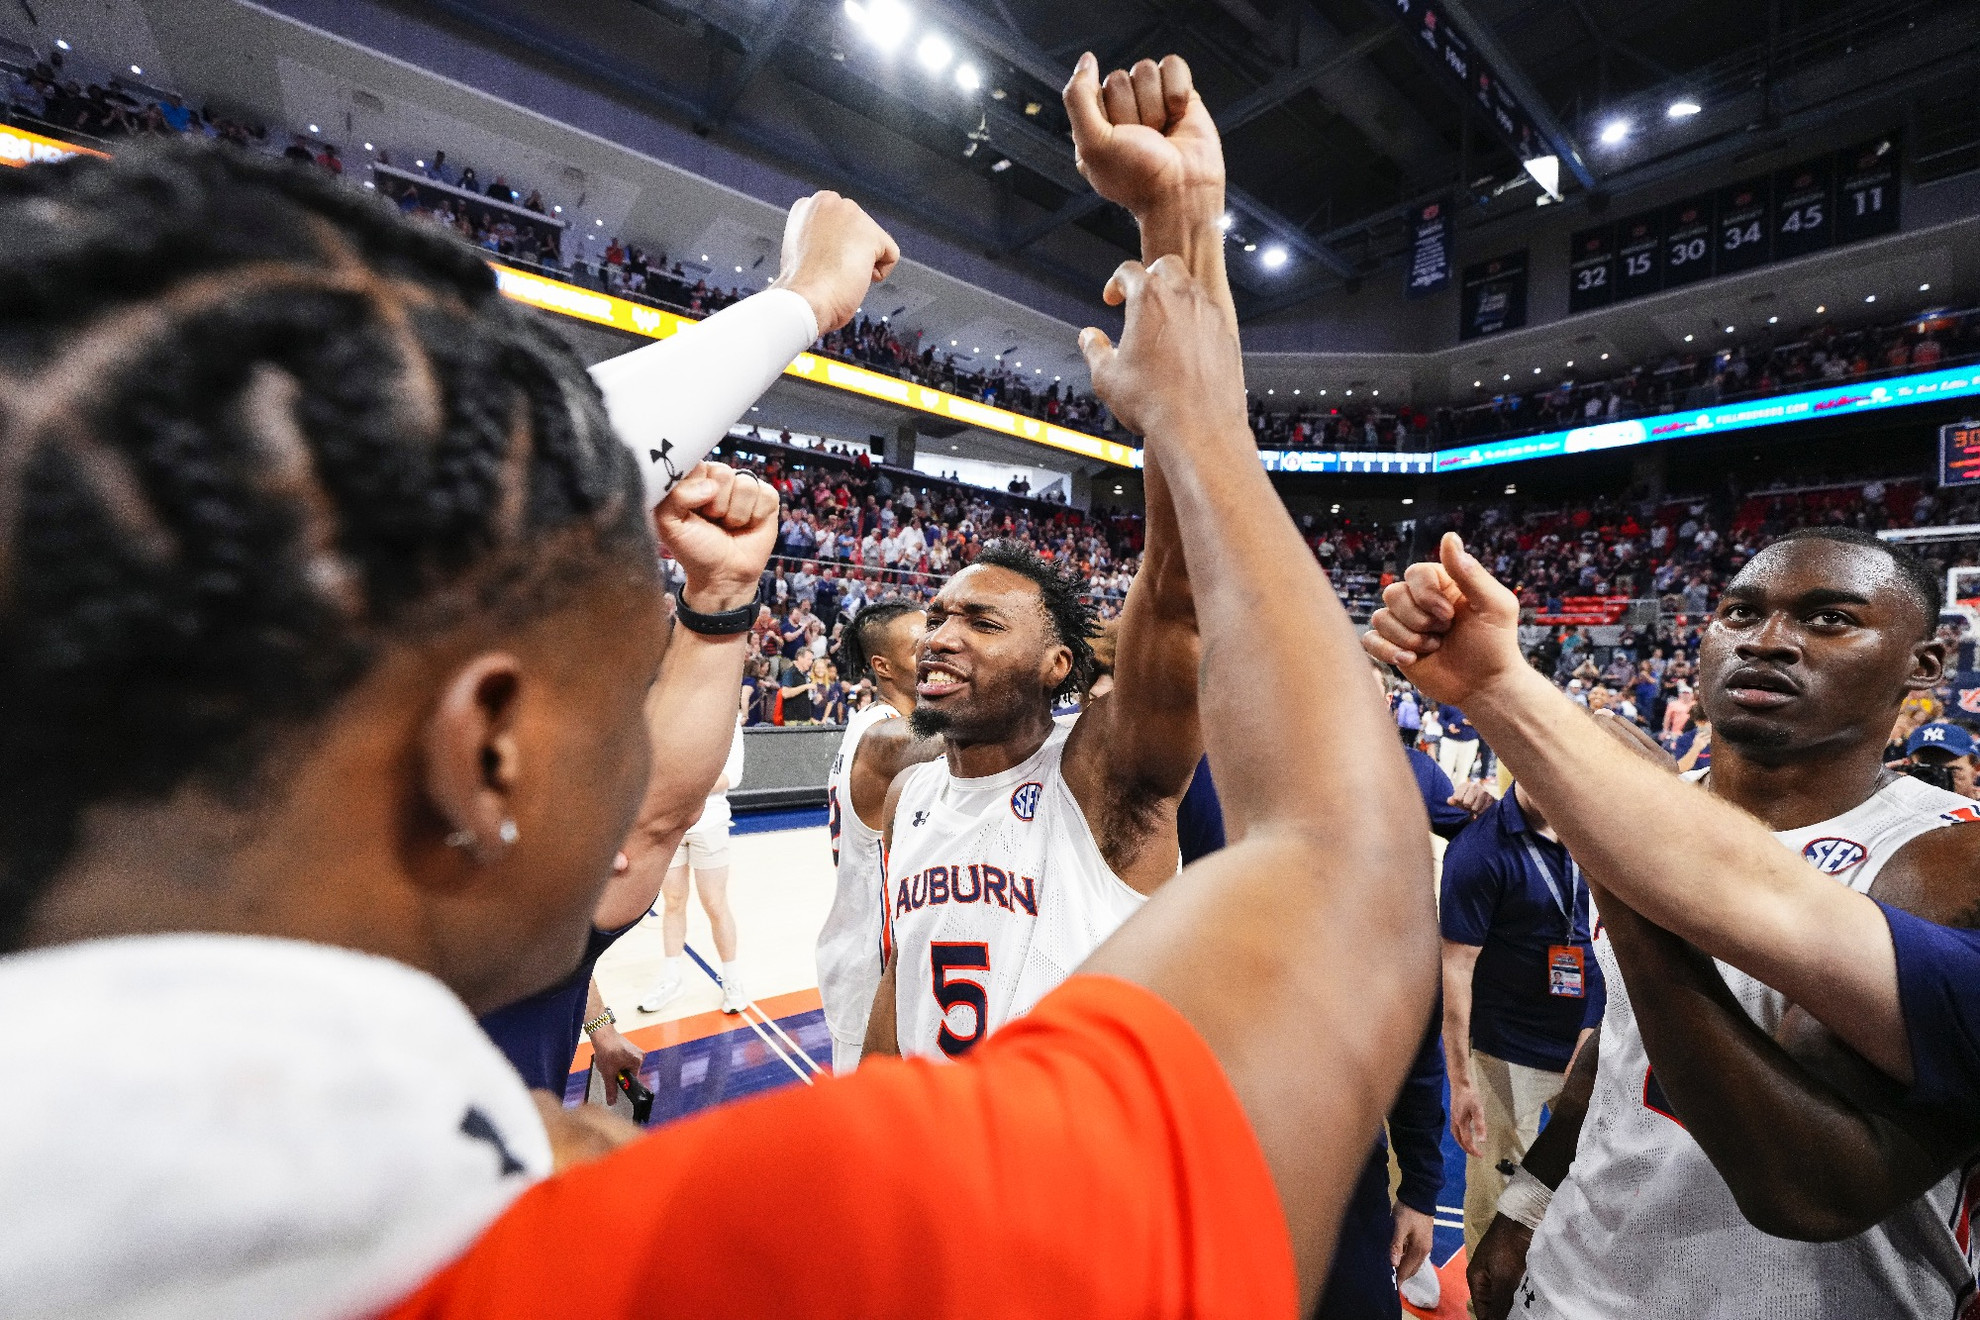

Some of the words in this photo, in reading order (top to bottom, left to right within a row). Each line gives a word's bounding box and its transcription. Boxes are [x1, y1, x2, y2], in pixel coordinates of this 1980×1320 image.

[1853, 187, 1884, 216] 11
[1781, 203, 1824, 234] 45
[1724, 221, 1762, 250] 34
[1626, 252, 1652, 277] 15
[1670, 238, 1706, 266] 30
[1577, 265, 1607, 291] 32
[1807, 840, 1866, 874] SEC
[896, 863, 1039, 920] AUBURN
[930, 940, 991, 1058] 5
